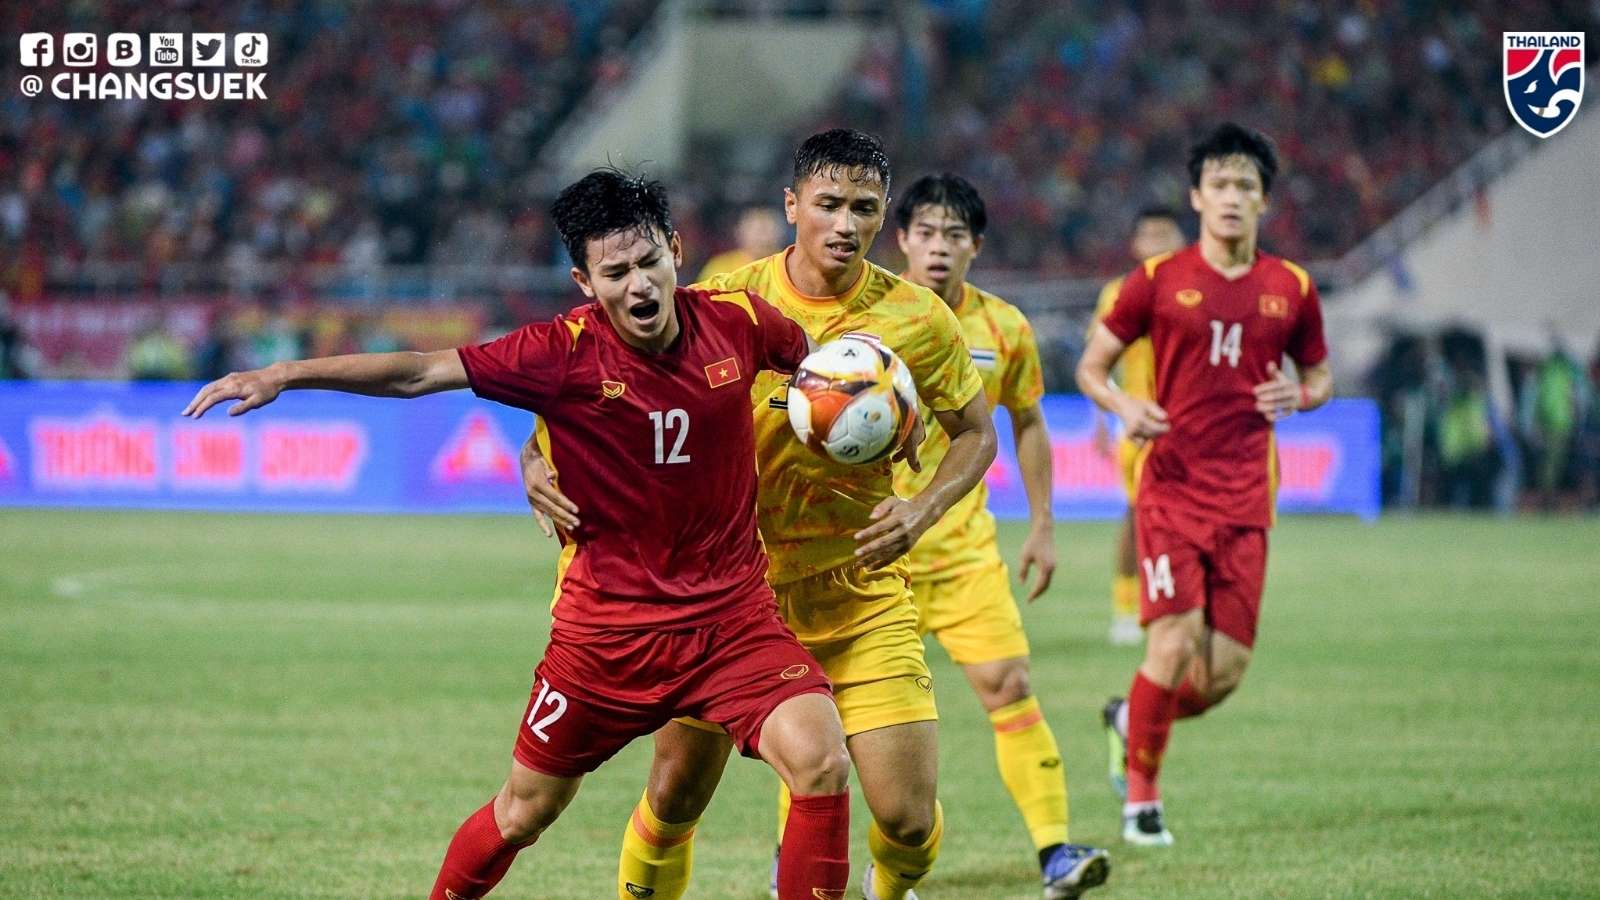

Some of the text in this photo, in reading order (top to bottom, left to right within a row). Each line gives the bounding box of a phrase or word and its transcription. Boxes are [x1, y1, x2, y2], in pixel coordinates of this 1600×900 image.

[1210, 320, 1243, 367] 14
[649, 408, 691, 465] 12
[1142, 554, 1175, 602] 14
[527, 677, 568, 743] 12
